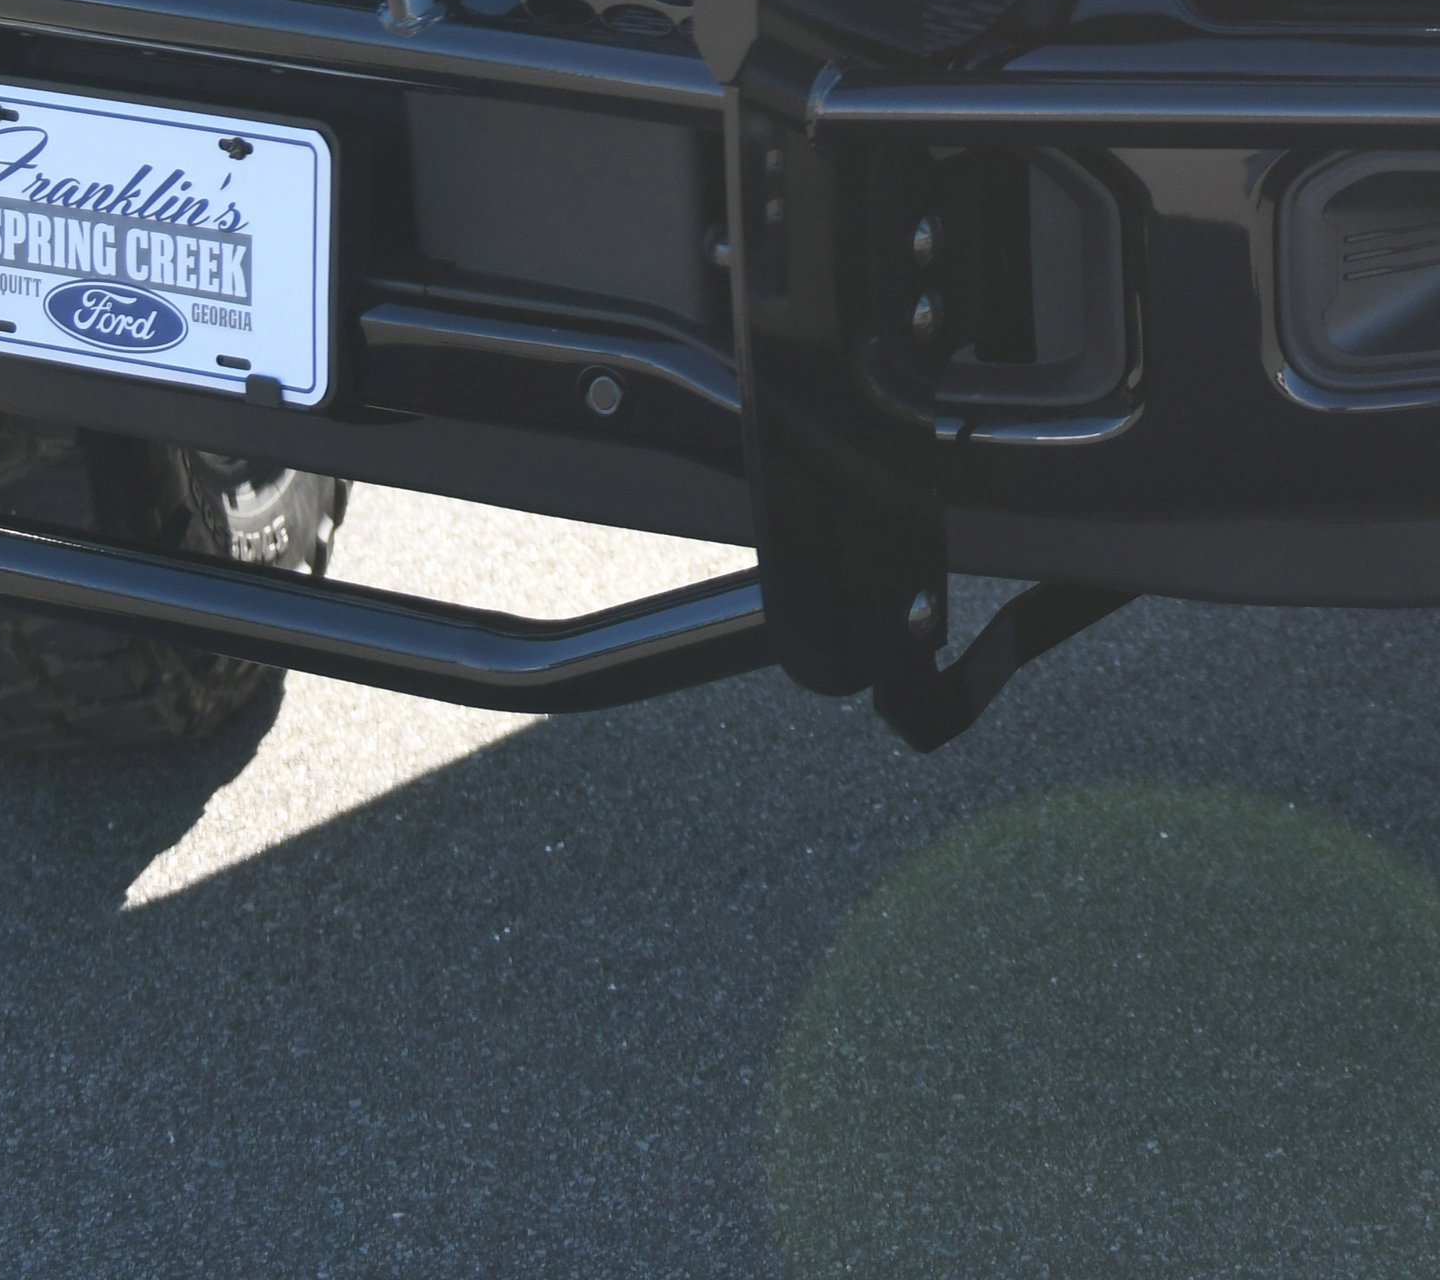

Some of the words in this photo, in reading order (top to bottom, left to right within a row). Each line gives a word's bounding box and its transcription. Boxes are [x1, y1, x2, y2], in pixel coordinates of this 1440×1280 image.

[126, 228, 248, 298] CREEK
[73, 288, 156, 341] Ford
[191, 302, 253, 333] GEORGIA
